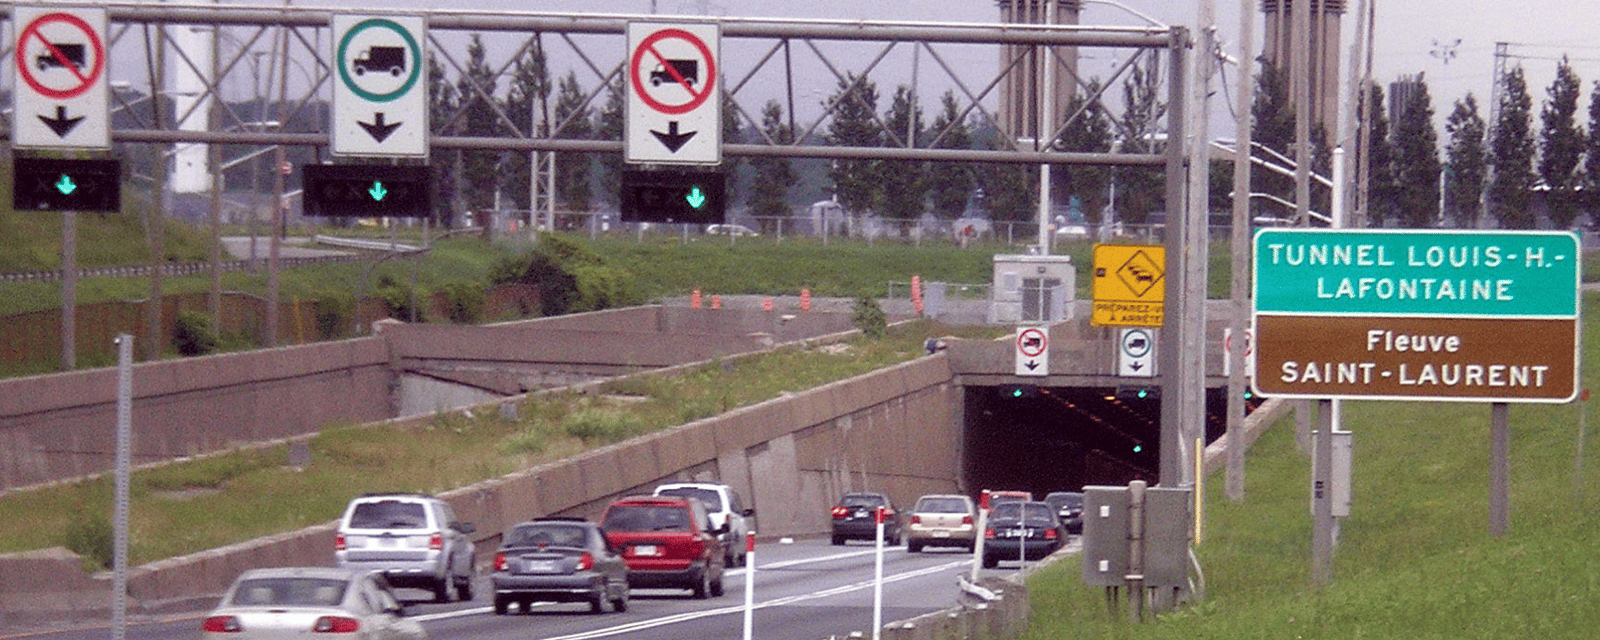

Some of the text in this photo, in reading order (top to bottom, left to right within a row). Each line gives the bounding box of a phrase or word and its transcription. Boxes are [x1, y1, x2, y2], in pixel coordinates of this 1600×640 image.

[1268, 243, 1395, 266] TUNNEL
[1317, 277, 1514, 301] LAFONTAINE
[1367, 330, 1461, 352] Fleuve
[1281, 361, 1549, 387] SAINT-LAURENT
